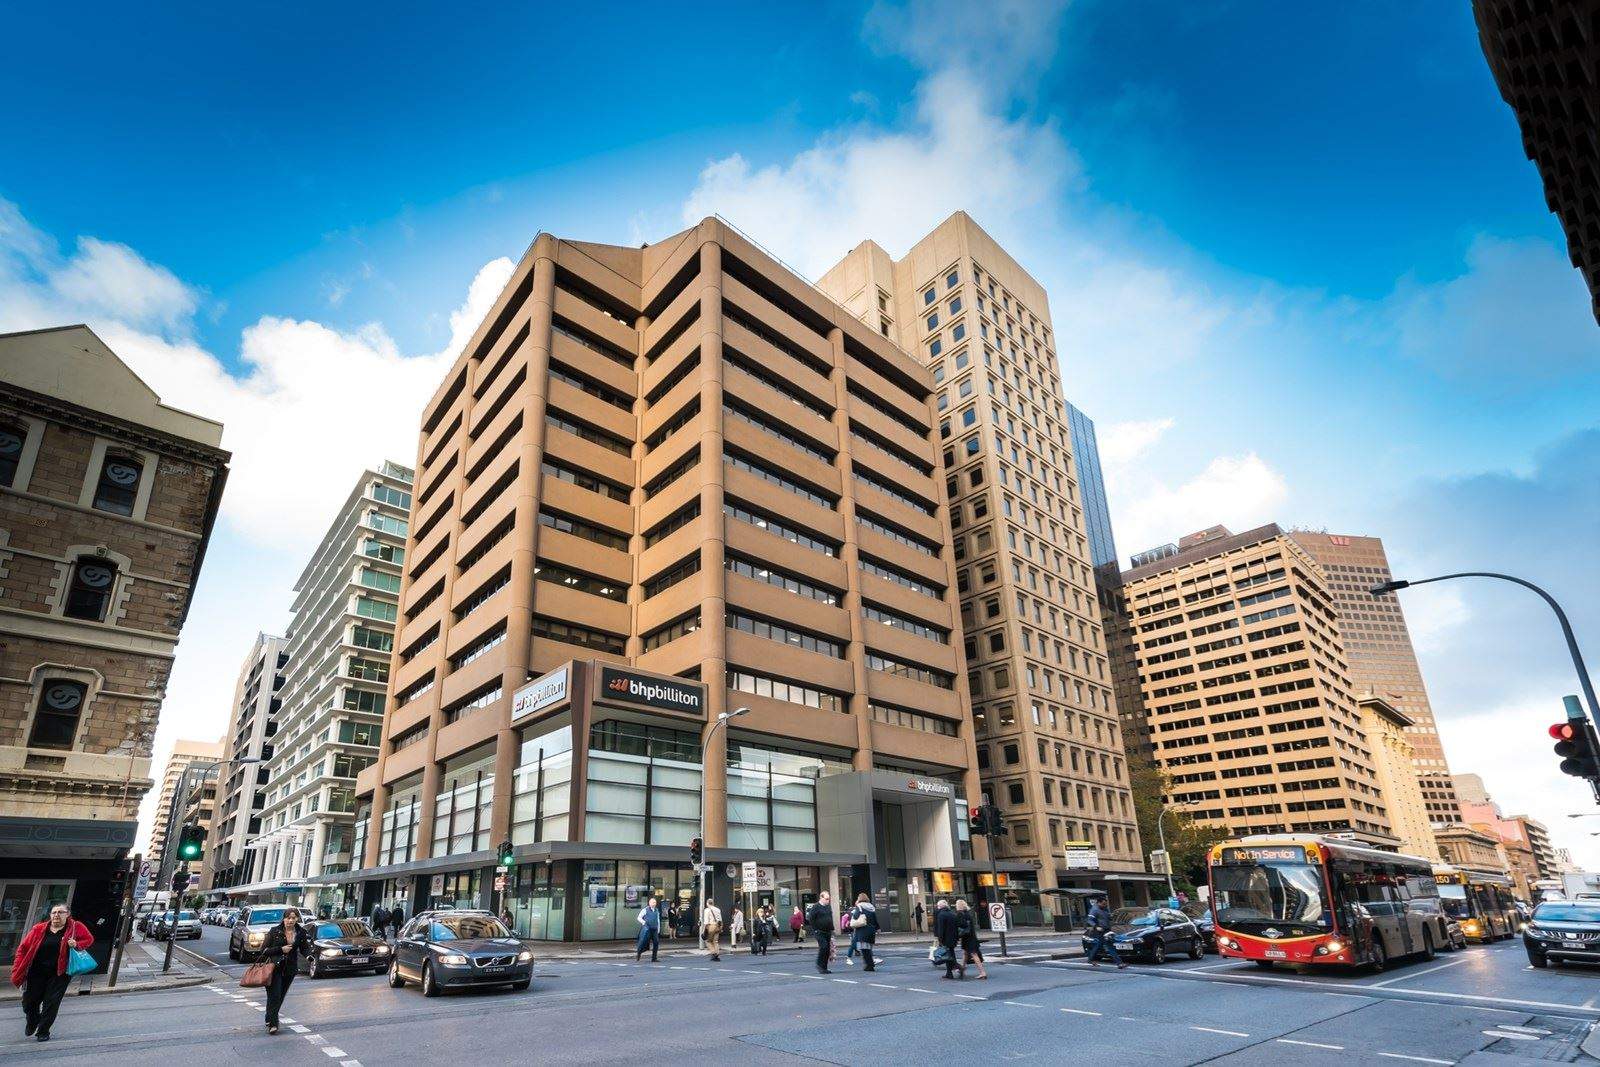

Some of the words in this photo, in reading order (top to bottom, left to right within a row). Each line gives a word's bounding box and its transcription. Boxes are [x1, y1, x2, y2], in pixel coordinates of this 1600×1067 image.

[629, 680, 699, 706] bhpbilliton
[917, 780, 950, 794] bhpbilliton
[1233, 850, 1250, 860] Not
[1250, 850, 1262, 859] In
[1262, 850, 1296, 860] Service
[757, 879, 771, 887] SBC
